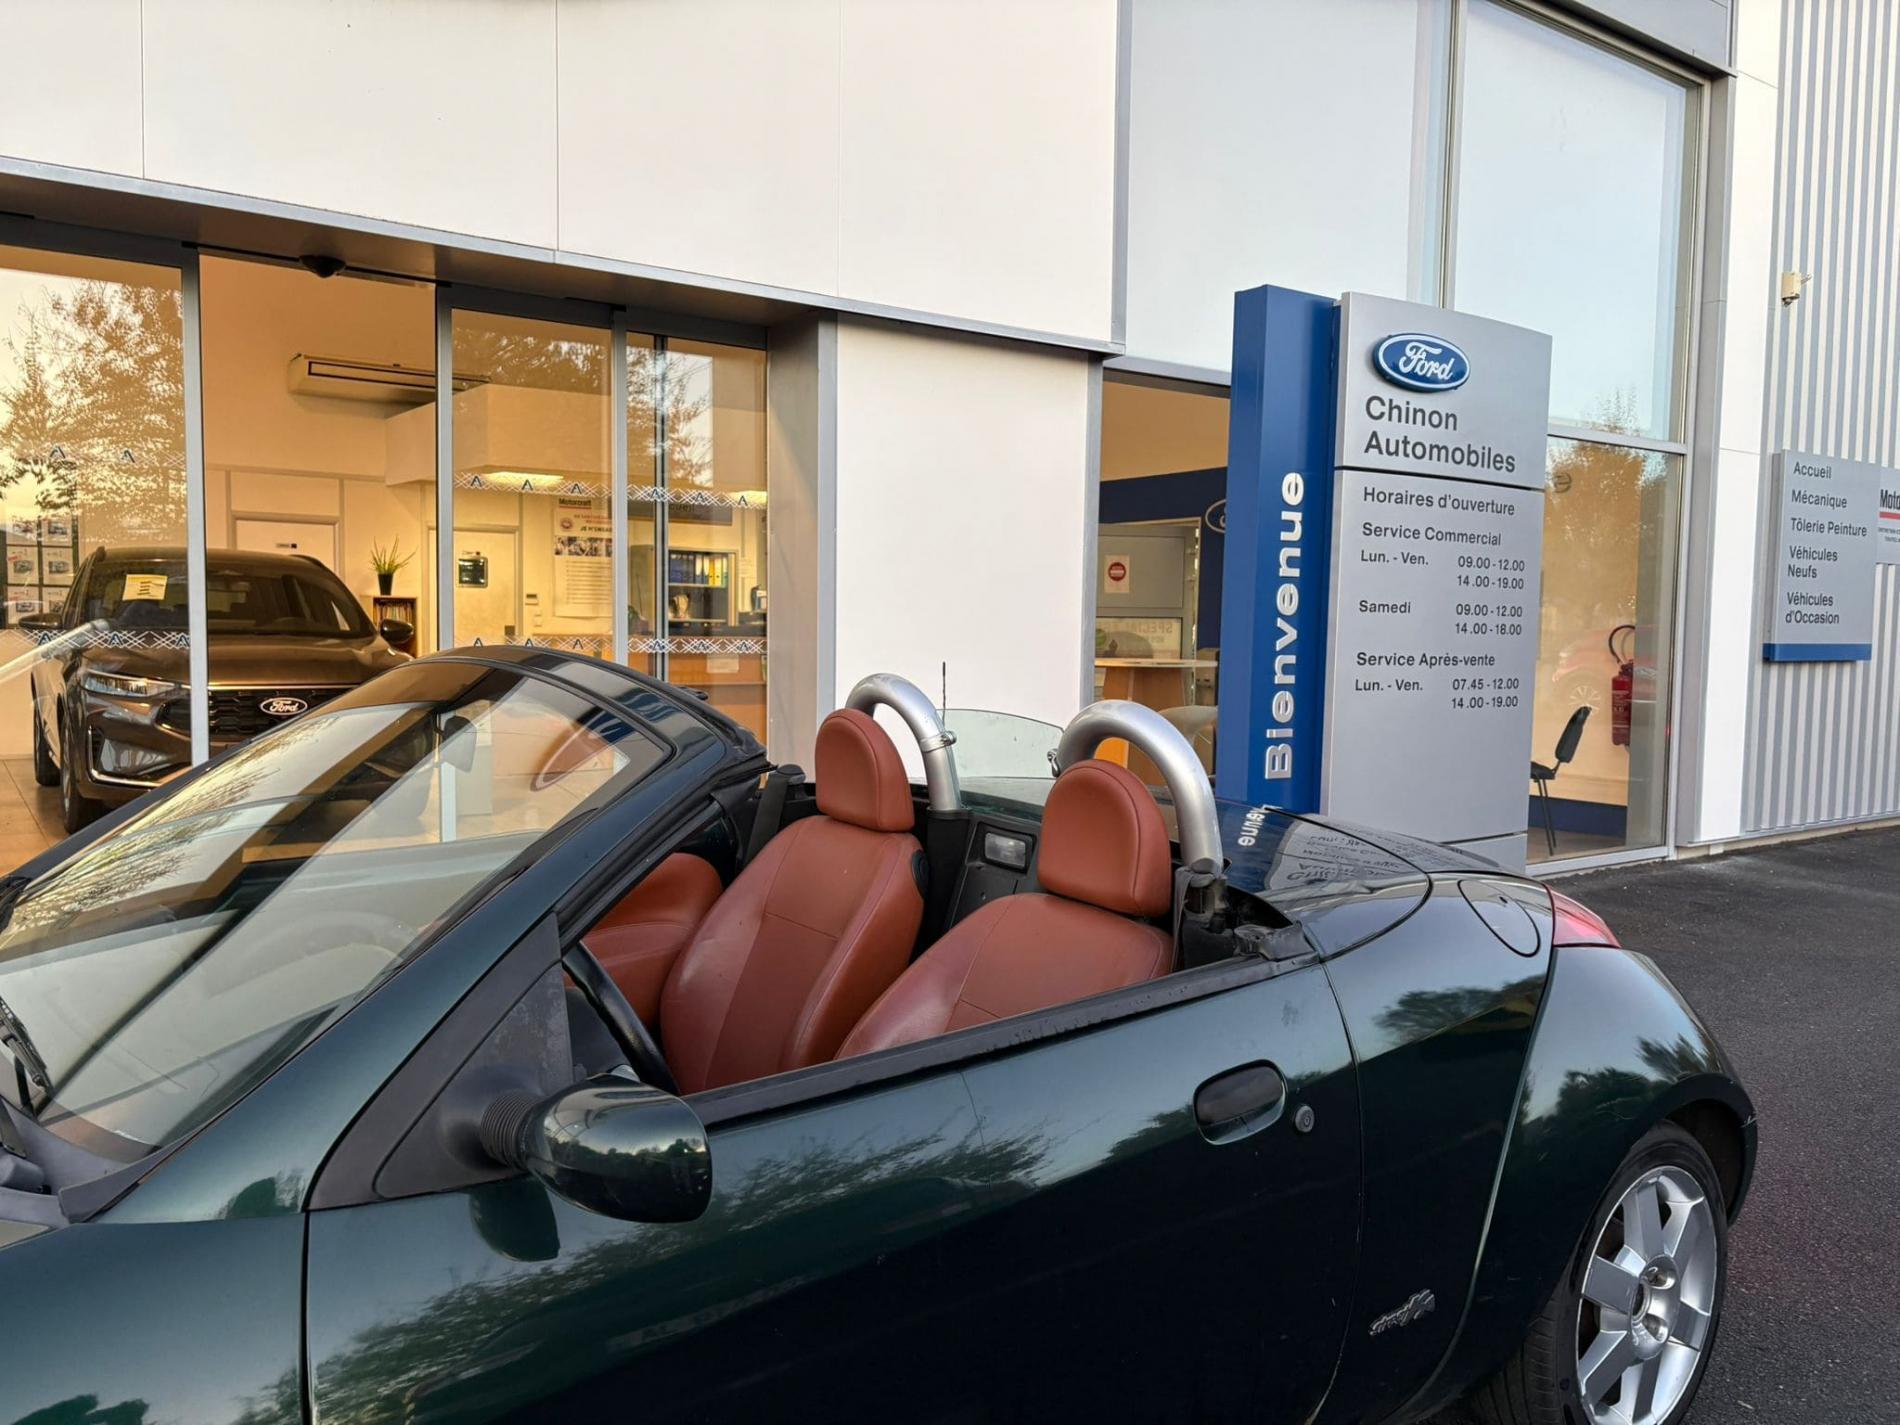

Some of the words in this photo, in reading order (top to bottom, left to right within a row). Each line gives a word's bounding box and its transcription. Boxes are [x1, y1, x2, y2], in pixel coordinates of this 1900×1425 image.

[1399, 341, 1455, 379] Ford
[1365, 395, 1458, 431] Chinon
[1364, 430, 1516, 473] Automobiles
[1793, 461, 1832, 479] Accueil
[1363, 486, 1434, 508] Horaires
[1438, 494, 1515, 516] d'ouverture
[1791, 489, 1848, 510] Mécanique
[1362, 522, 1421, 540] Service
[1424, 526, 1501, 546] Commercial
[1790, 517, 1825, 534] Tôlerie
[1827, 521, 1868, 537] Peinture
[1360, 550, 1390, 563] Lun.
[1401, 552, 1429, 565] Ven.
[1789, 545, 1838, 562] Véhicules
[1787, 564, 1818, 579] Neufs
[1359, 600, 1411, 614] Samedi
[1786, 592, 1834, 607] Véhicules
[1264, 472, 1305, 779] Bienvenue
[1785, 610, 1840, 625] d'Occasion
[1356, 652, 1415, 666] Service
[1418, 652, 1495, 669] Après-vente
[1355, 679, 1384, 691] Lun.
[1395, 679, 1423, 691] Ven.
[270, 700, 299, 712] Ford
